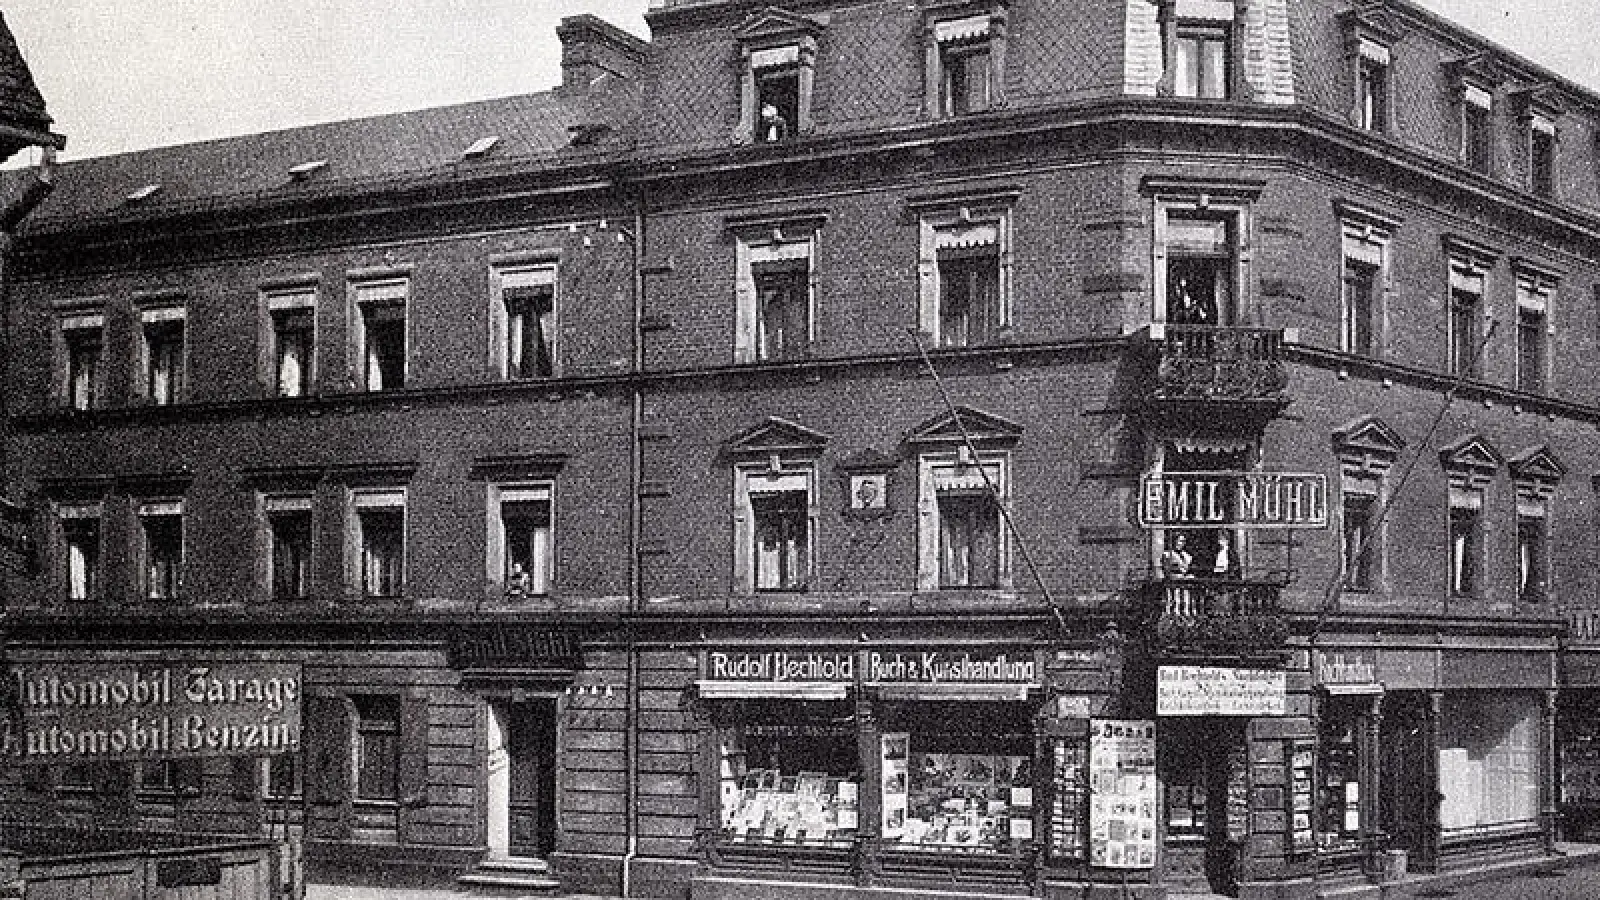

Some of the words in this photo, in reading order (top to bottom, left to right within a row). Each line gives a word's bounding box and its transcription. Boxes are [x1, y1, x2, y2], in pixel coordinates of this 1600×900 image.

[1145, 480, 1224, 522] EMIL
[711, 651, 771, 679] Rudolf
[871, 651, 906, 682] Buch
[907, 661, 919, 679] &
[921, 651, 1035, 684] Kunsthandlung
[184, 666, 299, 711] Garage
